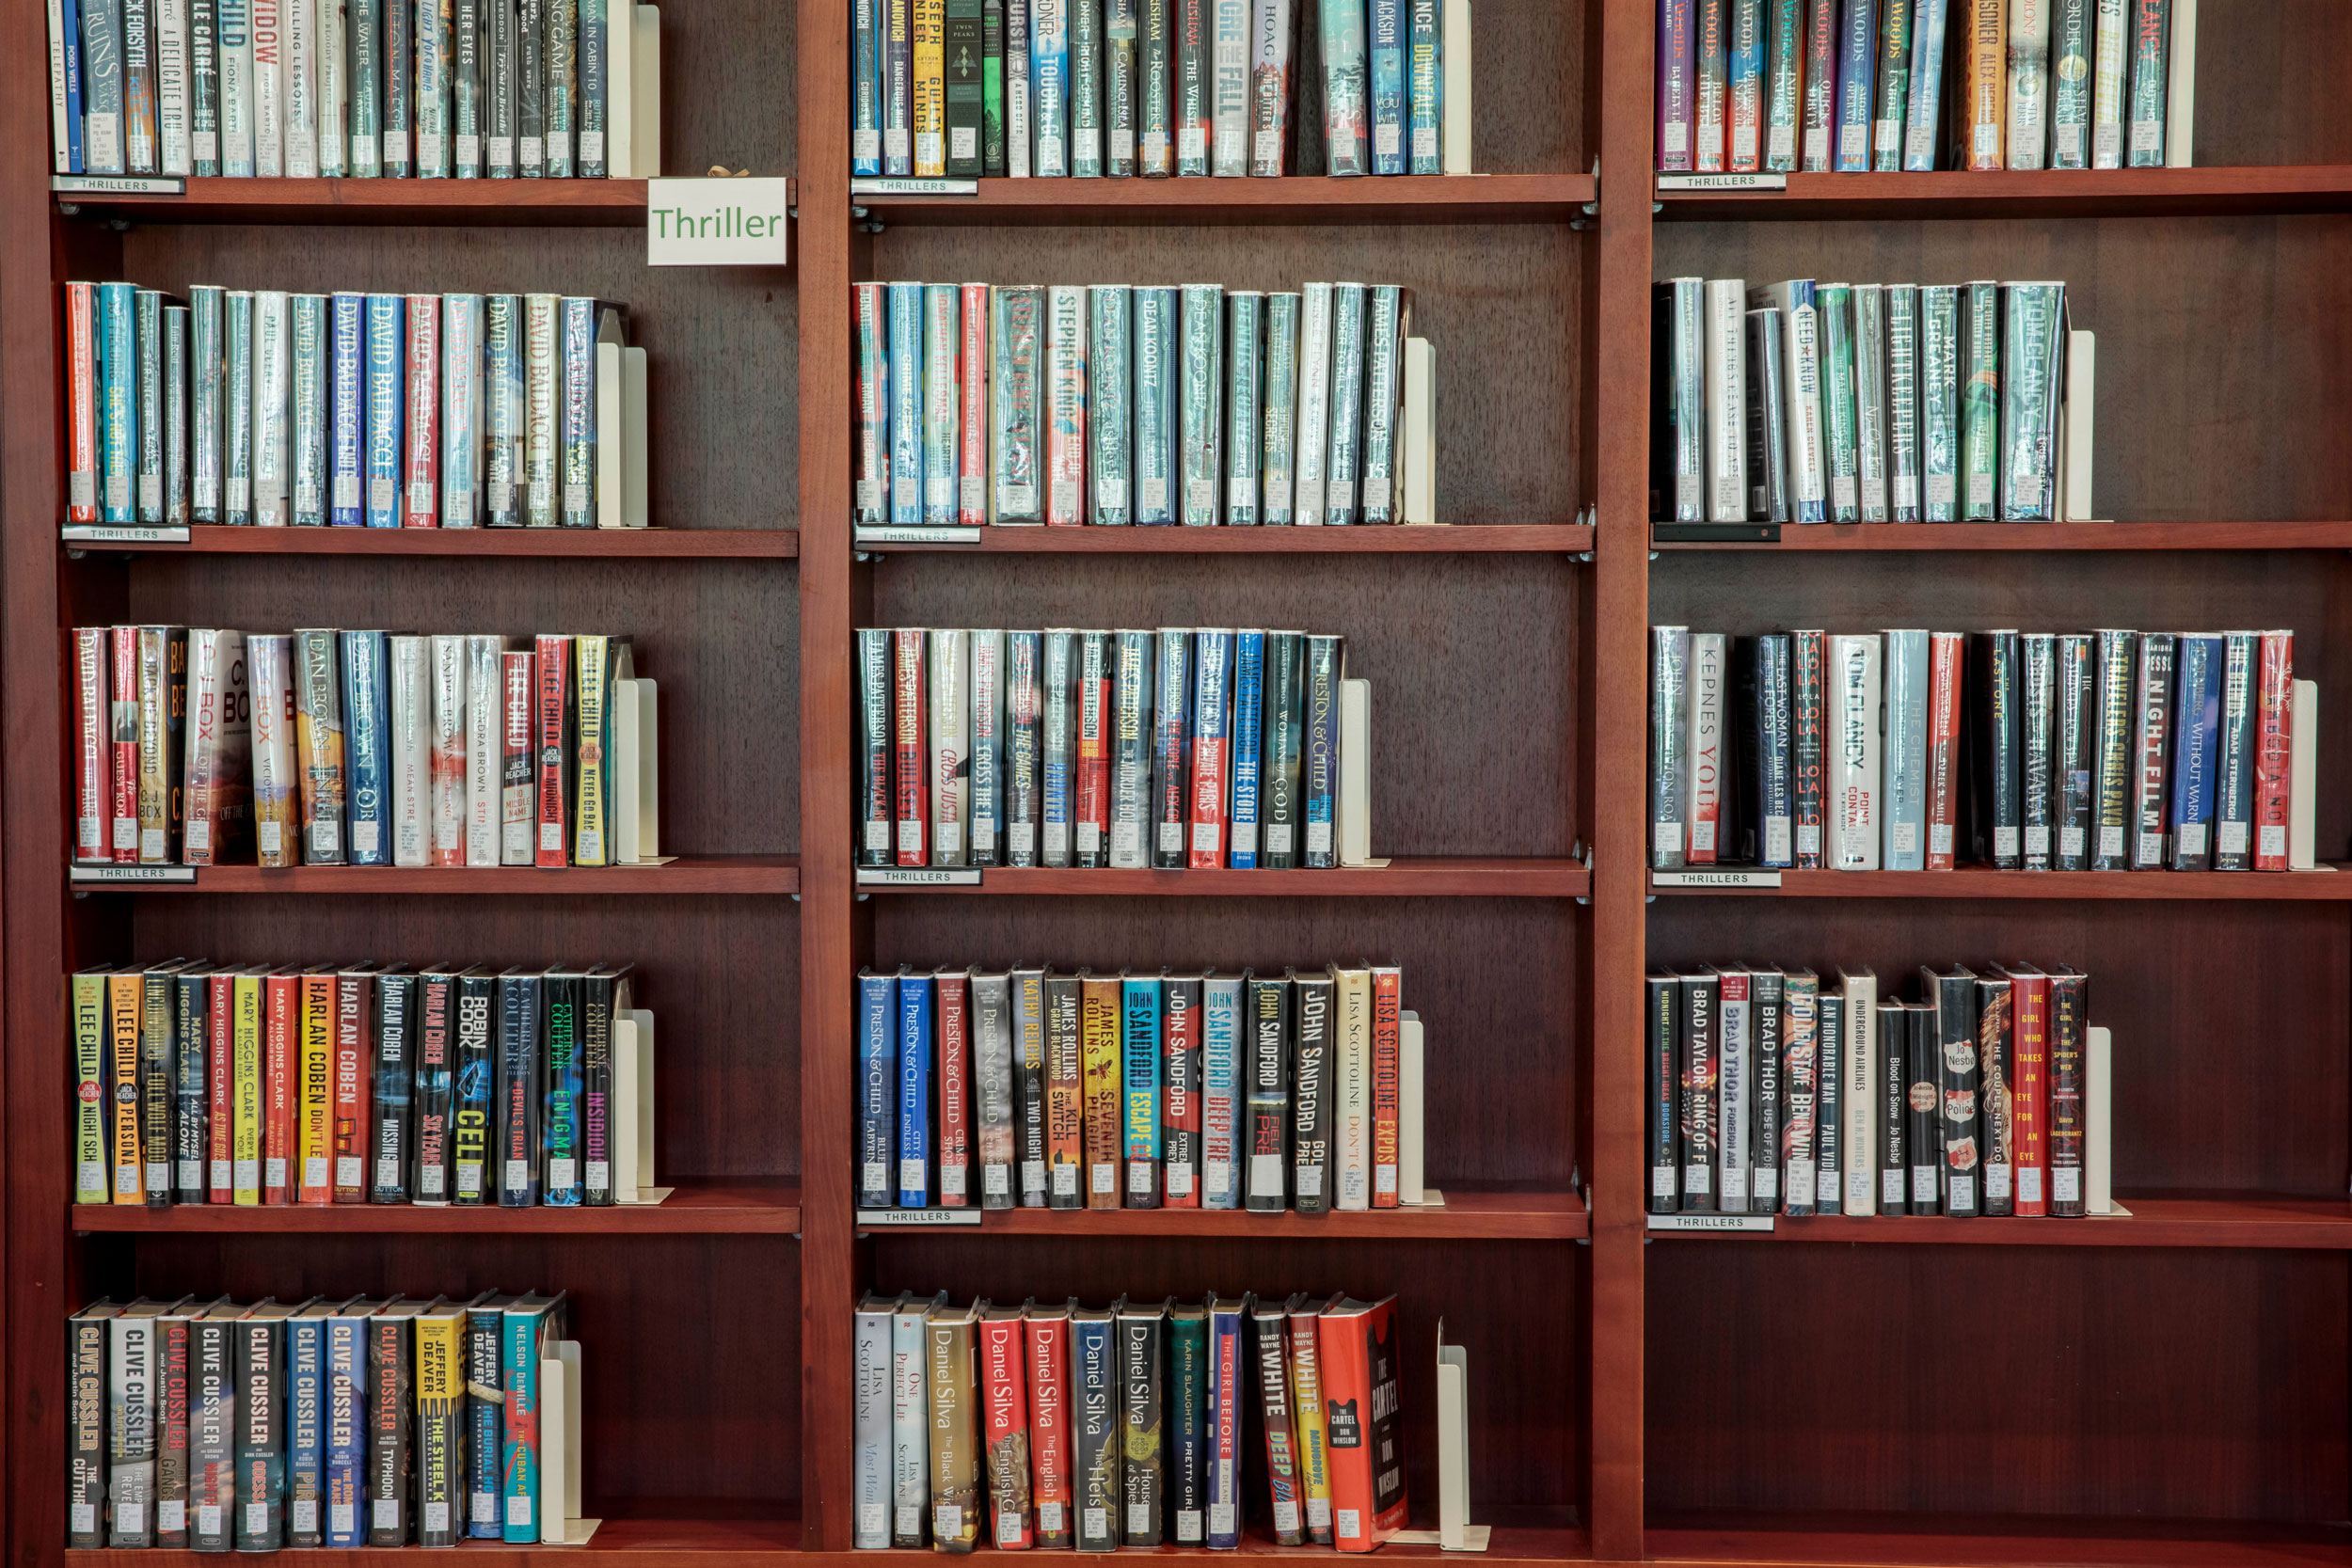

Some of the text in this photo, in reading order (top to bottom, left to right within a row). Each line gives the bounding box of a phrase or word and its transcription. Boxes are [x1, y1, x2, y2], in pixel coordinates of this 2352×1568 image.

[127, 15, 146, 68] FORSYTH
[193, 3, 215, 76] LE CARRÉ
[421, 2, 434, 32] LIGHT
[462, 6, 473, 64] HER EYES
[1264, 6, 1276, 56] HOAG
[1673, 3, 1685, 58] WOODS
[1706, 2, 1718, 58] WOODS
[1816, 3, 1829, 58] WOODS
[1853, 6, 1867, 61] WOODS
[1888, 3, 1903, 58] WOODS
[53, 40, 63, 107] TELEPATHY
[588, 27, 596, 90] IN CABIN 10
[1413, 44, 1434, 119] DOWNFALL
[1980, 54, 1994, 78] ALEX
[915, 81, 926, 133] MINDS
[930, 77, 941, 133] GUILTY
[1151, 60, 1163, 120] ROOSTER
[1218, 67, 1243, 116] FALL
[1806, 88, 1816, 127] DIRTY
[81, 179, 149, 191] THRILLERS
[880, 180, 946, 191] THRILLERS
[1687, 176, 1756, 187] THRILLERS
[651, 206, 782, 239] Thriller
[1144, 301, 1156, 387] DEAN KOONTZ
[2026, 297, 2046, 340] TOM
[337, 302, 357, 440] DAVID BALDACCI
[489, 303, 506, 434] DAVID BALDACCI
[530, 306, 548, 451] DAVID BALDACCI
[1057, 295, 1076, 417] STEPHEN KING
[1798, 311, 1816, 393] NEED KNOW
[1929, 320, 1941, 404] GREANEY
[1944, 336, 1955, 387] MARK
[372, 306, 394, 467] DAVID BALDACCI
[902, 354, 913, 439] CRIME SCENE
[1890, 316, 1915, 454] LIGHTKEEPERS
[2023, 342, 2043, 418] CLANCY
[90, 530, 159, 540] THRILLERS
[882, 531, 949, 541] THRILLERS
[310, 639, 329, 751] DAN BROWN
[544, 669, 560, 740] LEE CHILD
[582, 669, 598, 737] LEE CHILD
[1238, 651, 1259, 754] JAMES PATTERSON
[1279, 710, 1287, 760] WOMAN
[1697, 649, 1716, 807] KEPNES YOU
[1910, 698, 1921, 805] THE CHEMIST
[2143, 680, 2164, 826] NIGHT FILM
[583, 768, 596, 796] NEVER
[941, 749, 957, 785] CROSS
[1046, 763, 1067, 823] HAUNTED
[1235, 761, 1256, 821] THE STORE
[2228, 758, 2238, 819] STERNBERGH
[546, 778, 557, 823] MIDNIGHT
[1274, 778, 1288, 821] GOD
[99, 868, 166, 878] THRILLERS
[884, 872, 951, 881] THRILLERS
[1680, 874, 1749, 884] THRILLERS
[80, 1006, 96, 1030] LEE
[459, 996, 473, 1048] COOK
[472, 996, 488, 1049] ROBIN
[1024, 979, 1040, 1069] KATHY REICHS
[1087, 998, 1100, 1054] ROLLINS
[1100, 1005, 1114, 1047] JAMES
[1661, 990, 1670, 1025] MIDNIGHT
[81, 1035, 97, 1075] CHILD
[215, 984, 225, 1105] MARY HIGGINS CLARK
[309, 983, 327, 1103] HARLAN COBEN
[946, 1006, 961, 1123] PRESTON & CHILD
[1170, 990, 1185, 1117] JOHN SANDFORD
[1377, 994, 1396, 1110] LISA SCOTTOLINE
[1762, 1006, 1775, 1101] BRAD THOR
[1855, 999, 1866, 1091] UNDERGROUND AIRLINES
[1027, 1100, 1040, 1122] TWO
[1890, 1057, 1900, 1119] Blood on Snow
[83, 1107, 97, 1137] NIGHT
[214, 1112, 227, 1141] AS TIME
[310, 1110, 323, 1141] DON'T
[553, 1090, 570, 1160] ENIGMA
[1087, 1096, 1099, 1153] PLAGUE
[1100, 1091, 1114, 1162] SEVENTH
[1763, 1109, 1772, 1147] USE OF
[1889, 1126, 1900, 1164] Jo Nesbø
[884, 1212, 951, 1222] THRILLERS
[1676, 1217, 1744, 1227] THRILLERS
[424, 1342, 434, 1392] DEAVER
[435, 1340, 446, 1394] JEFFERY
[516, 1325, 526, 1367] NELSON
[79, 1327, 99, 1450] CLIVE CUSSLER
[1037, 1329, 1057, 1428] Daniel Silva
[1221, 1362, 1232, 1394] GIRL
[1295, 1348, 1318, 1414] WHITE
[1221, 1399, 1232, 1453] BEFORE
[382, 1449, 393, 1499] TYPHOON
[1041, 1434, 1057, 1497] The English
